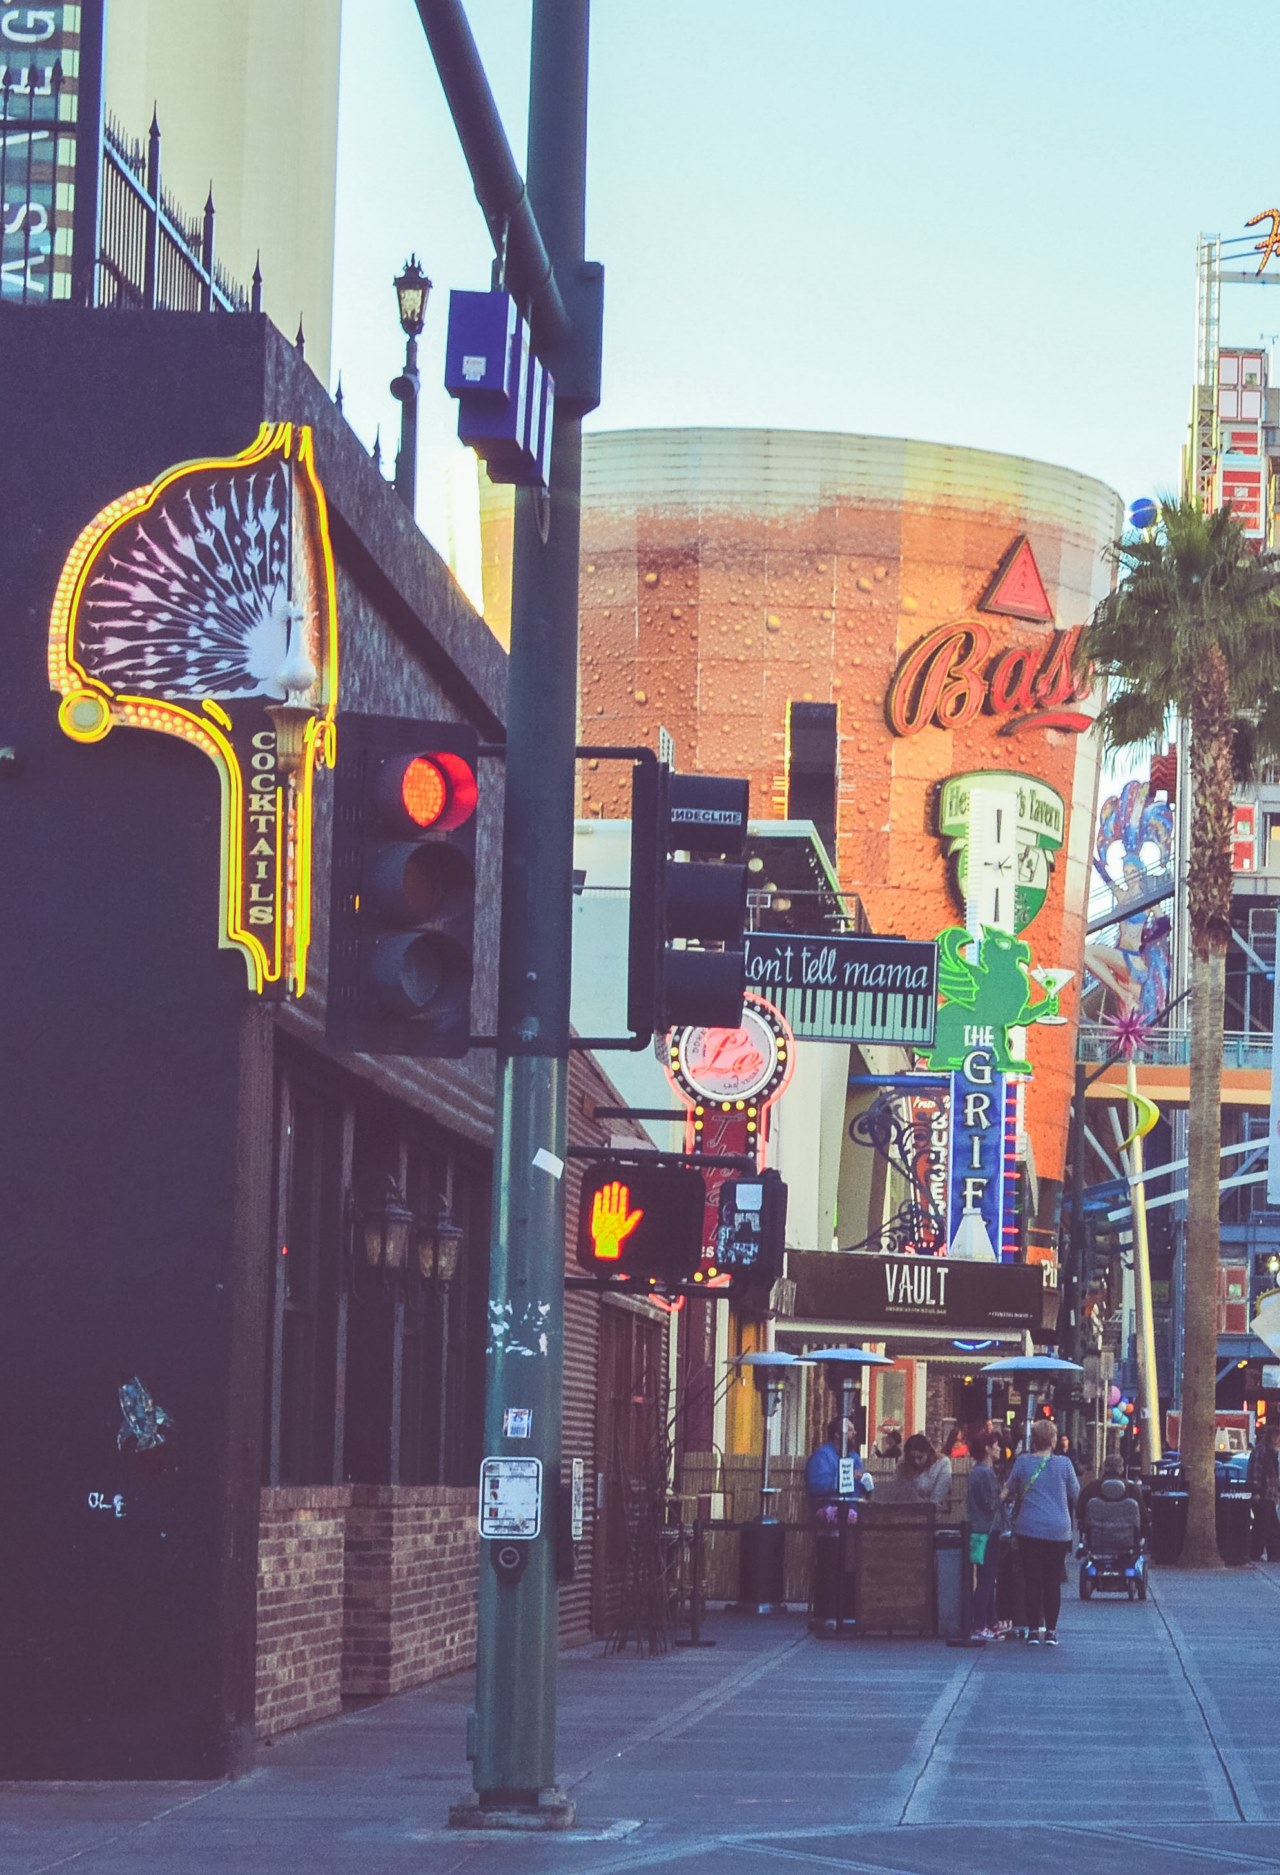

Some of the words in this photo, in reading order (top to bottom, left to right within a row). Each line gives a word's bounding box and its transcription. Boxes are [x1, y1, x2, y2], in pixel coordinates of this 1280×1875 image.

[248, 731, 277, 925] COCKTAILS
[1028, 788, 1061, 832] Tavern
[799, 945, 838, 984] tell
[843, 961, 929, 989] mama
[963, 1025, 995, 1048] THE
[962, 1050, 994, 1211] GRIF
[884, 1263, 949, 1306] VAULT
